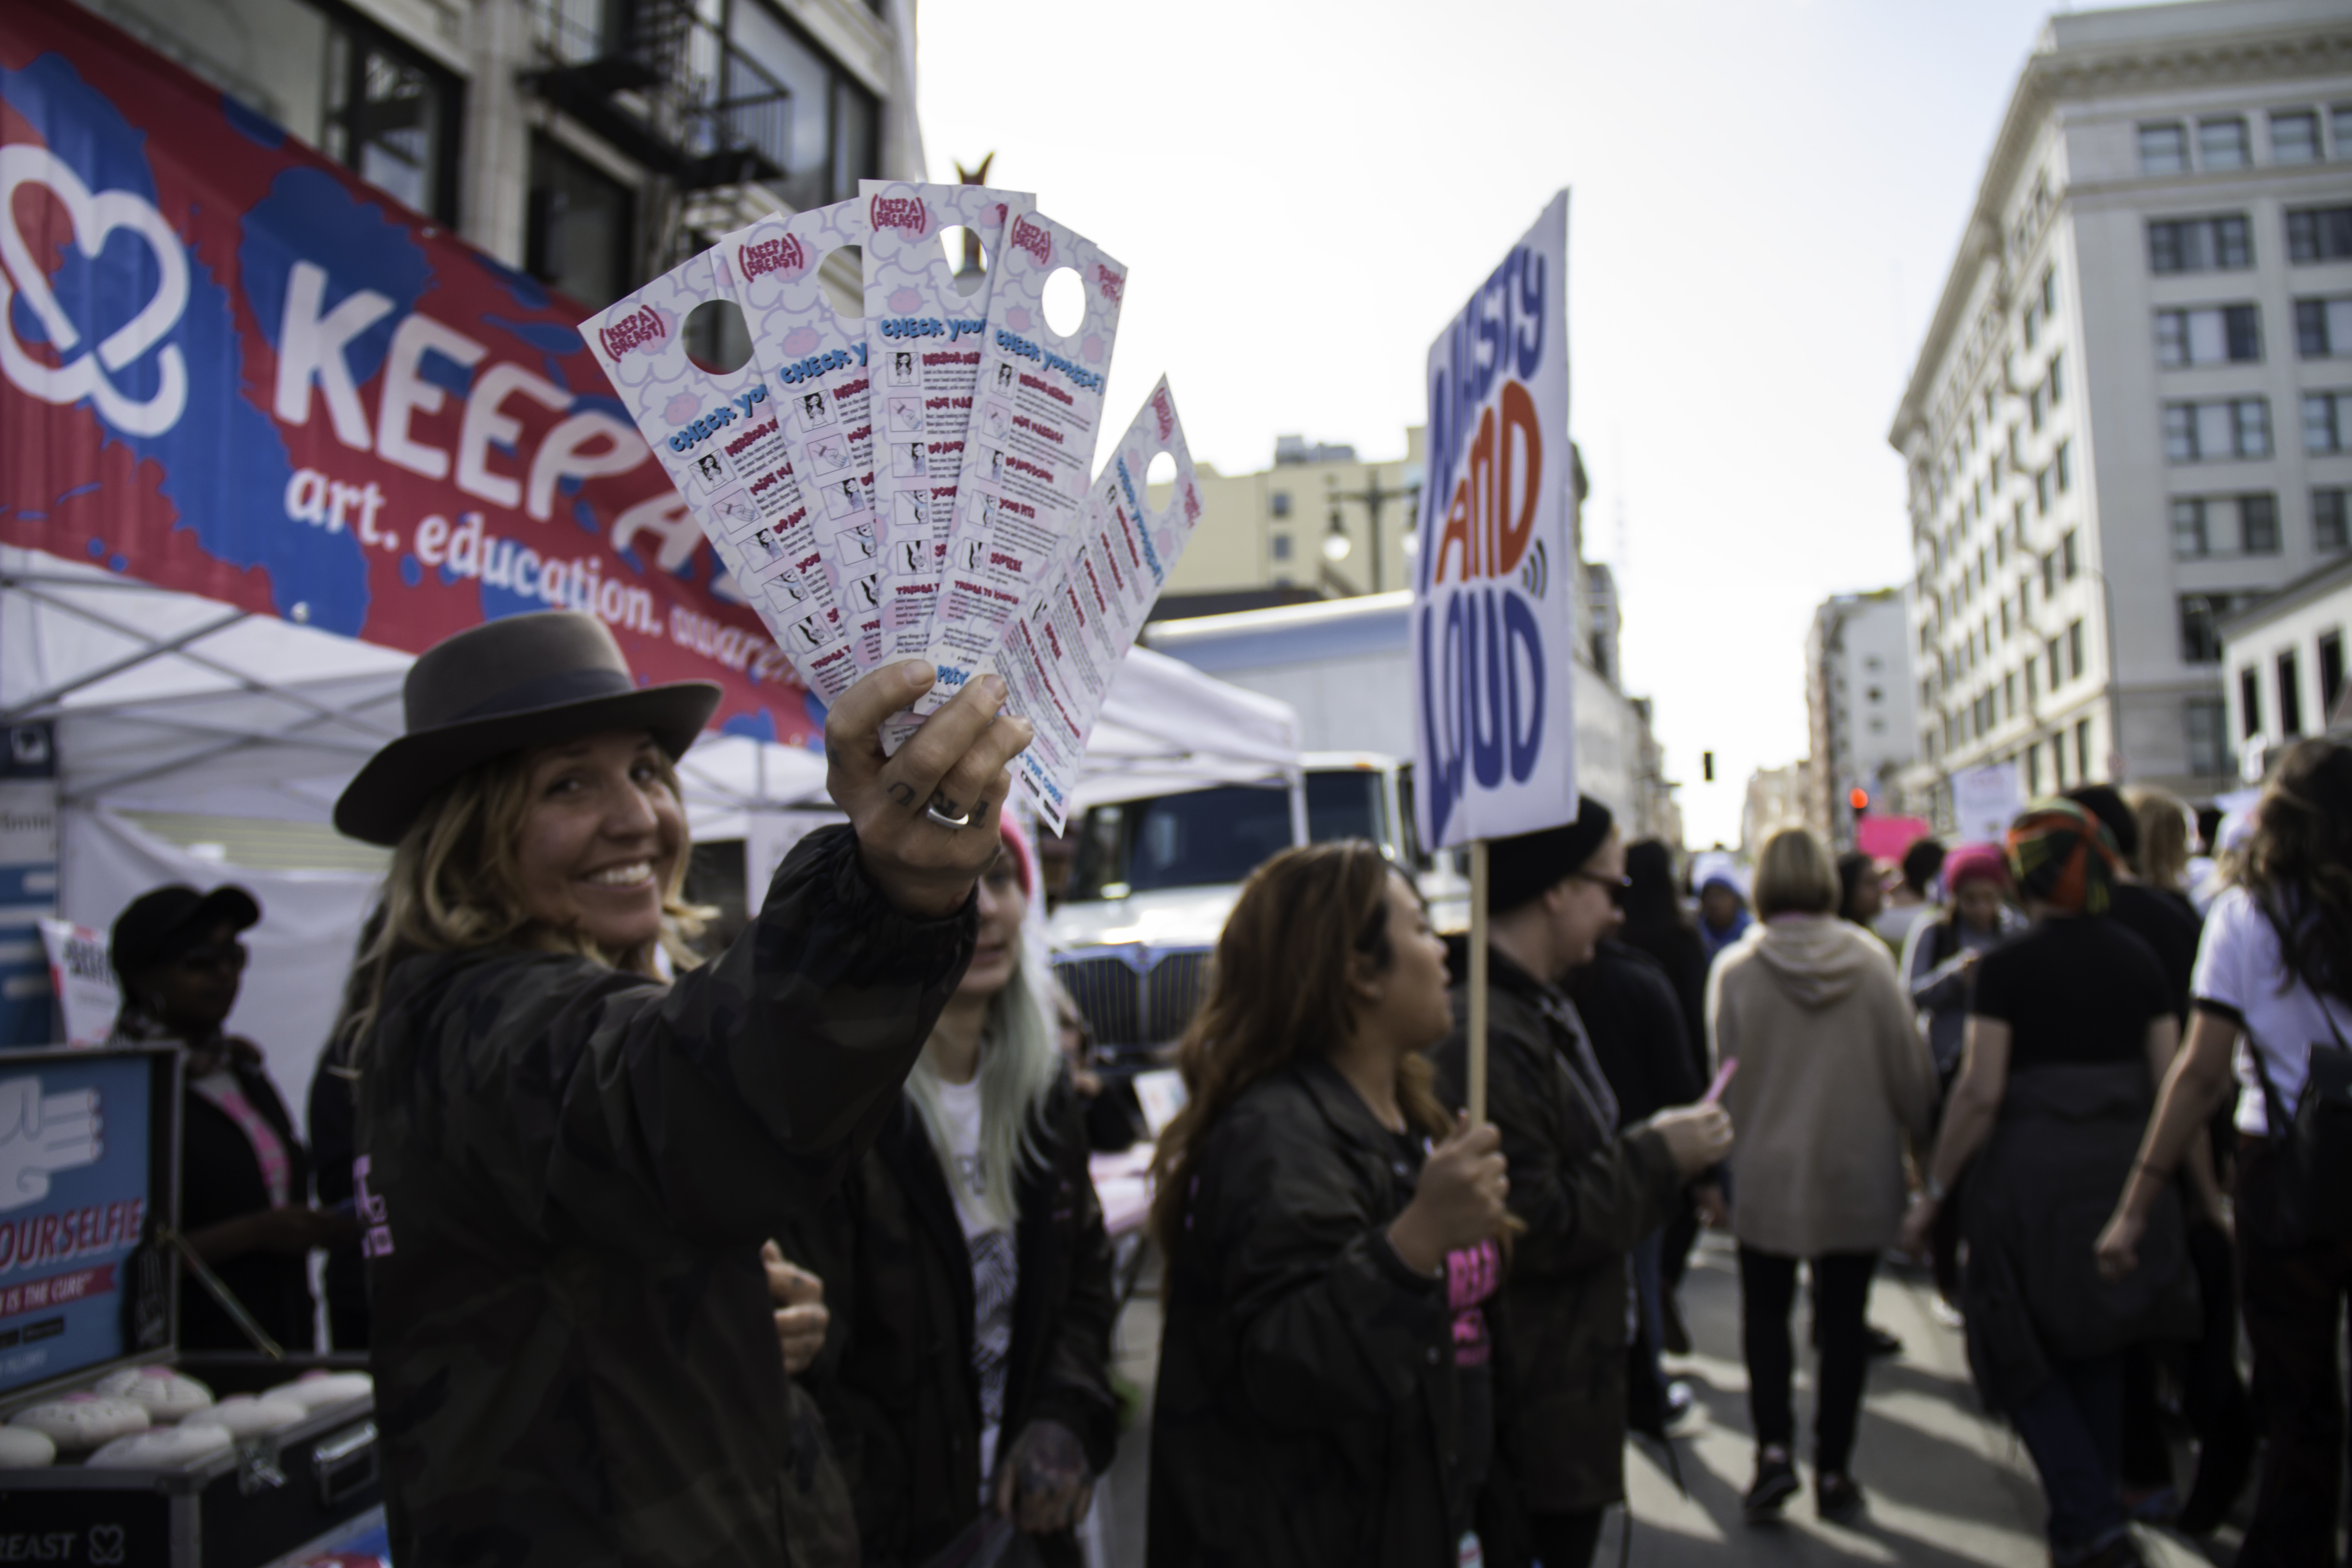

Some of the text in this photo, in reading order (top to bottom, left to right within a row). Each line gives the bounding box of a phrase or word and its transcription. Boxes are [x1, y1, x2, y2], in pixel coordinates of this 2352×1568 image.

[875, 211, 922, 230] BREAST
[877, 198, 919, 216] KEEP A
[747, 239, 793, 260] KEEP A
[748, 254, 798, 277] BREAST
[607, 313, 651, 343] KEEP A
[612, 329, 658, 356] BREAST
[880, 317, 944, 340] CHECK
[995, 328, 1040, 361] CHECK
[779, 349, 852, 384] CHECK
[274, 260, 652, 522] KEEP
[668, 406, 737, 452] CHECK
[725, 424, 771, 457] MIRROR
[773, 519, 788, 534] UP
[285, 466, 398, 553] art.
[413, 510, 665, 636] education.
[1423, 588, 1544, 846] LOUD
